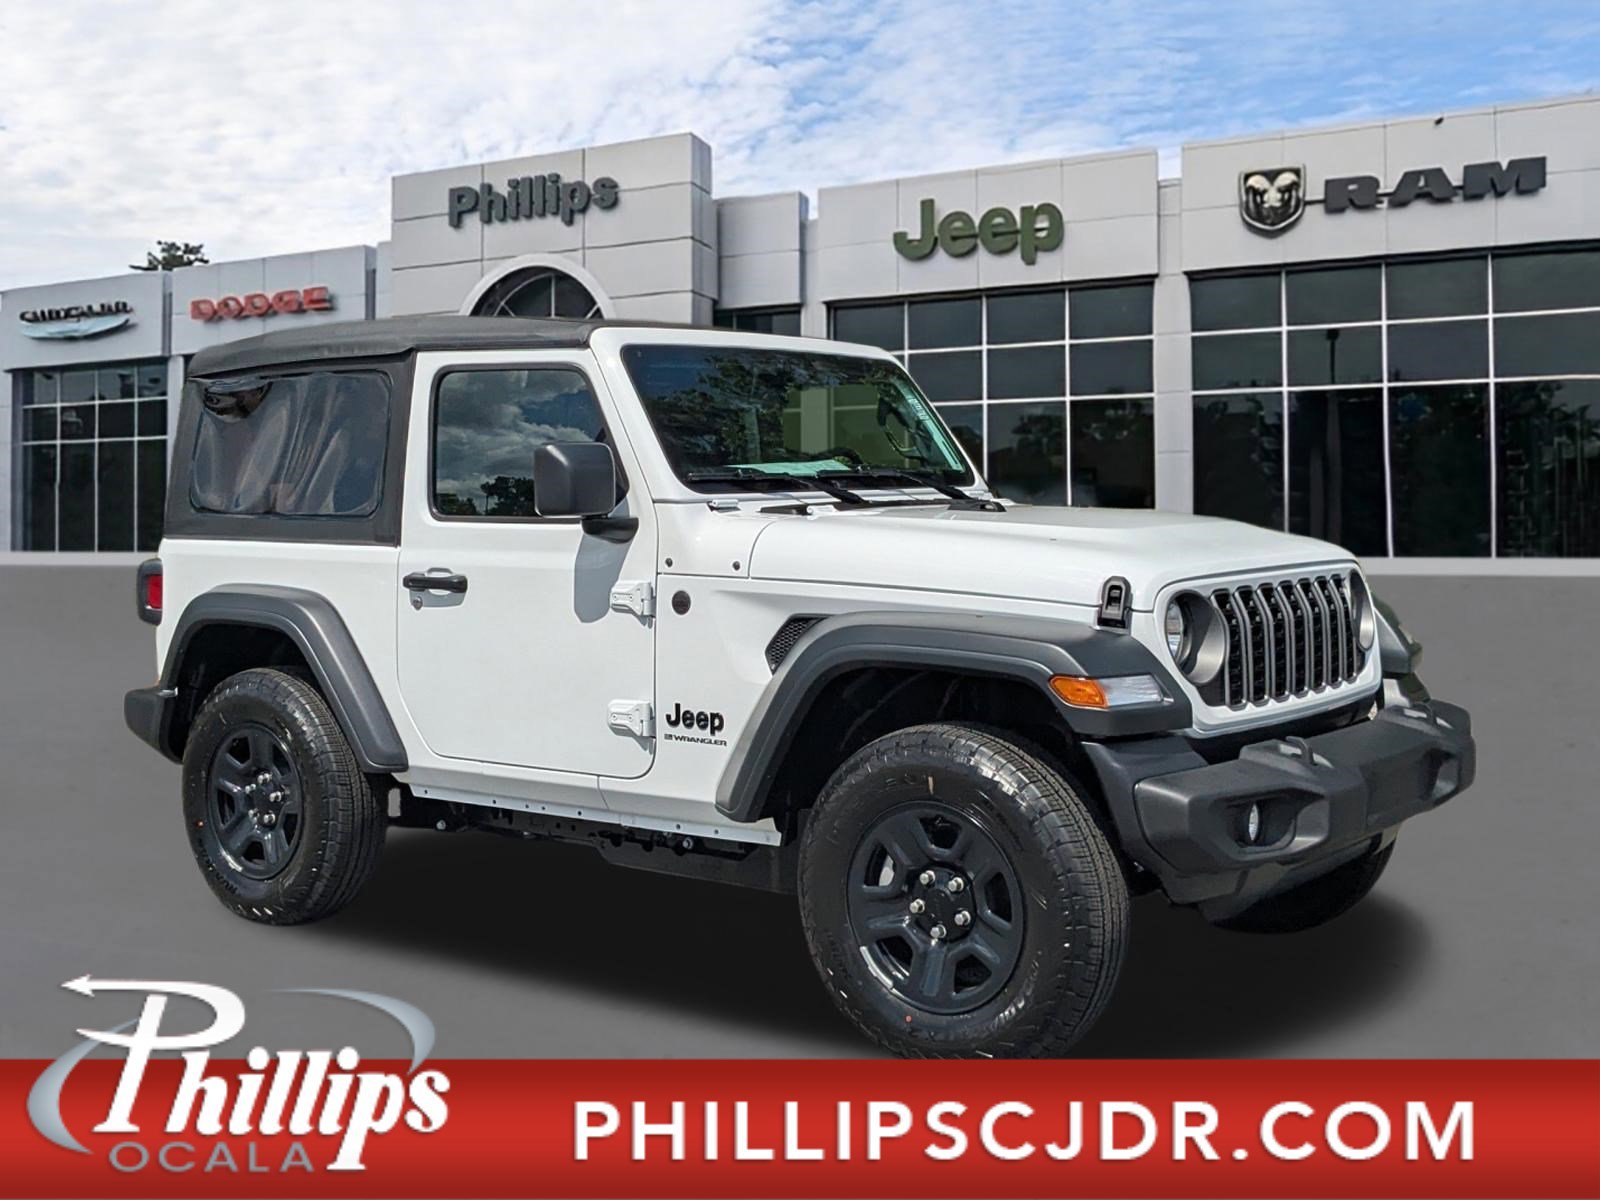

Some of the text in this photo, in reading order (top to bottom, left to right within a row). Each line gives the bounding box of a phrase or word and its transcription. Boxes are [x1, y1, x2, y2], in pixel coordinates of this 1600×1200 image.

[448, 172, 620, 228] Phillips
[1325, 157, 1547, 214] RAM
[893, 198, 1064, 266] Jeep
[190, 286, 334, 322] DODGE
[665, 703, 724, 736] Jeep
[674, 735, 727, 746] WRANGLER
